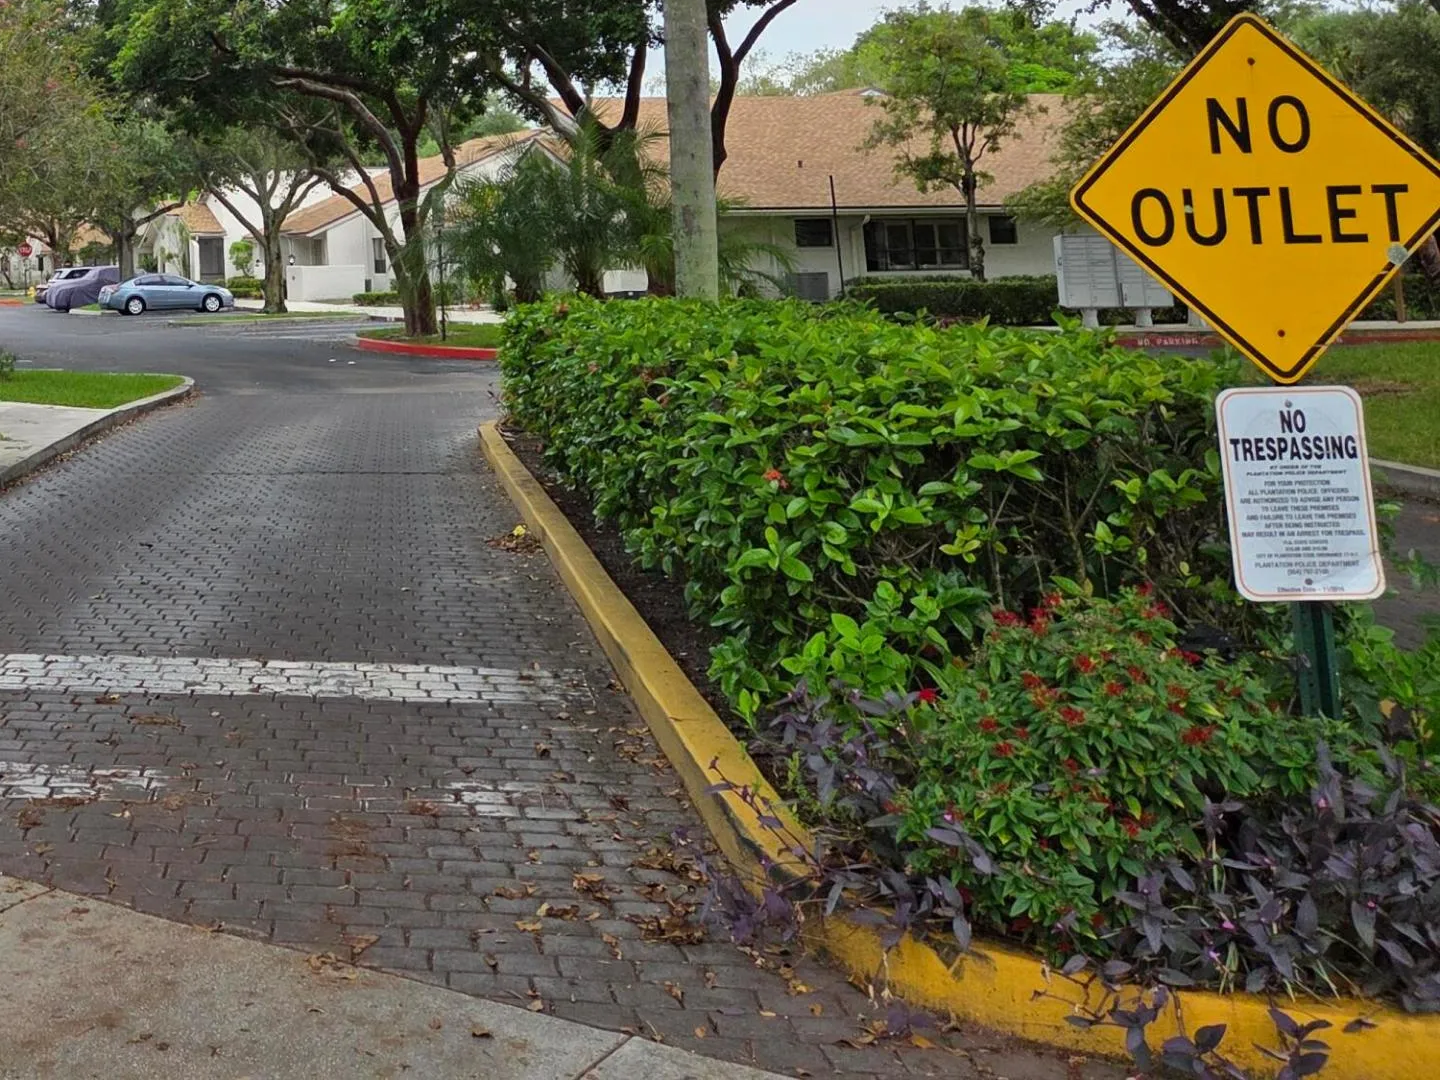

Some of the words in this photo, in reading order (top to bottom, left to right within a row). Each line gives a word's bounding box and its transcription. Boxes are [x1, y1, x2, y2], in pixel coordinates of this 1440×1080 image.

[1206, 95, 1311, 154] NO
[1130, 183, 1409, 247] OUTLET
[1279, 408, 1306, 434] NO
[1229, 435, 1358, 462] TRESPASSING
